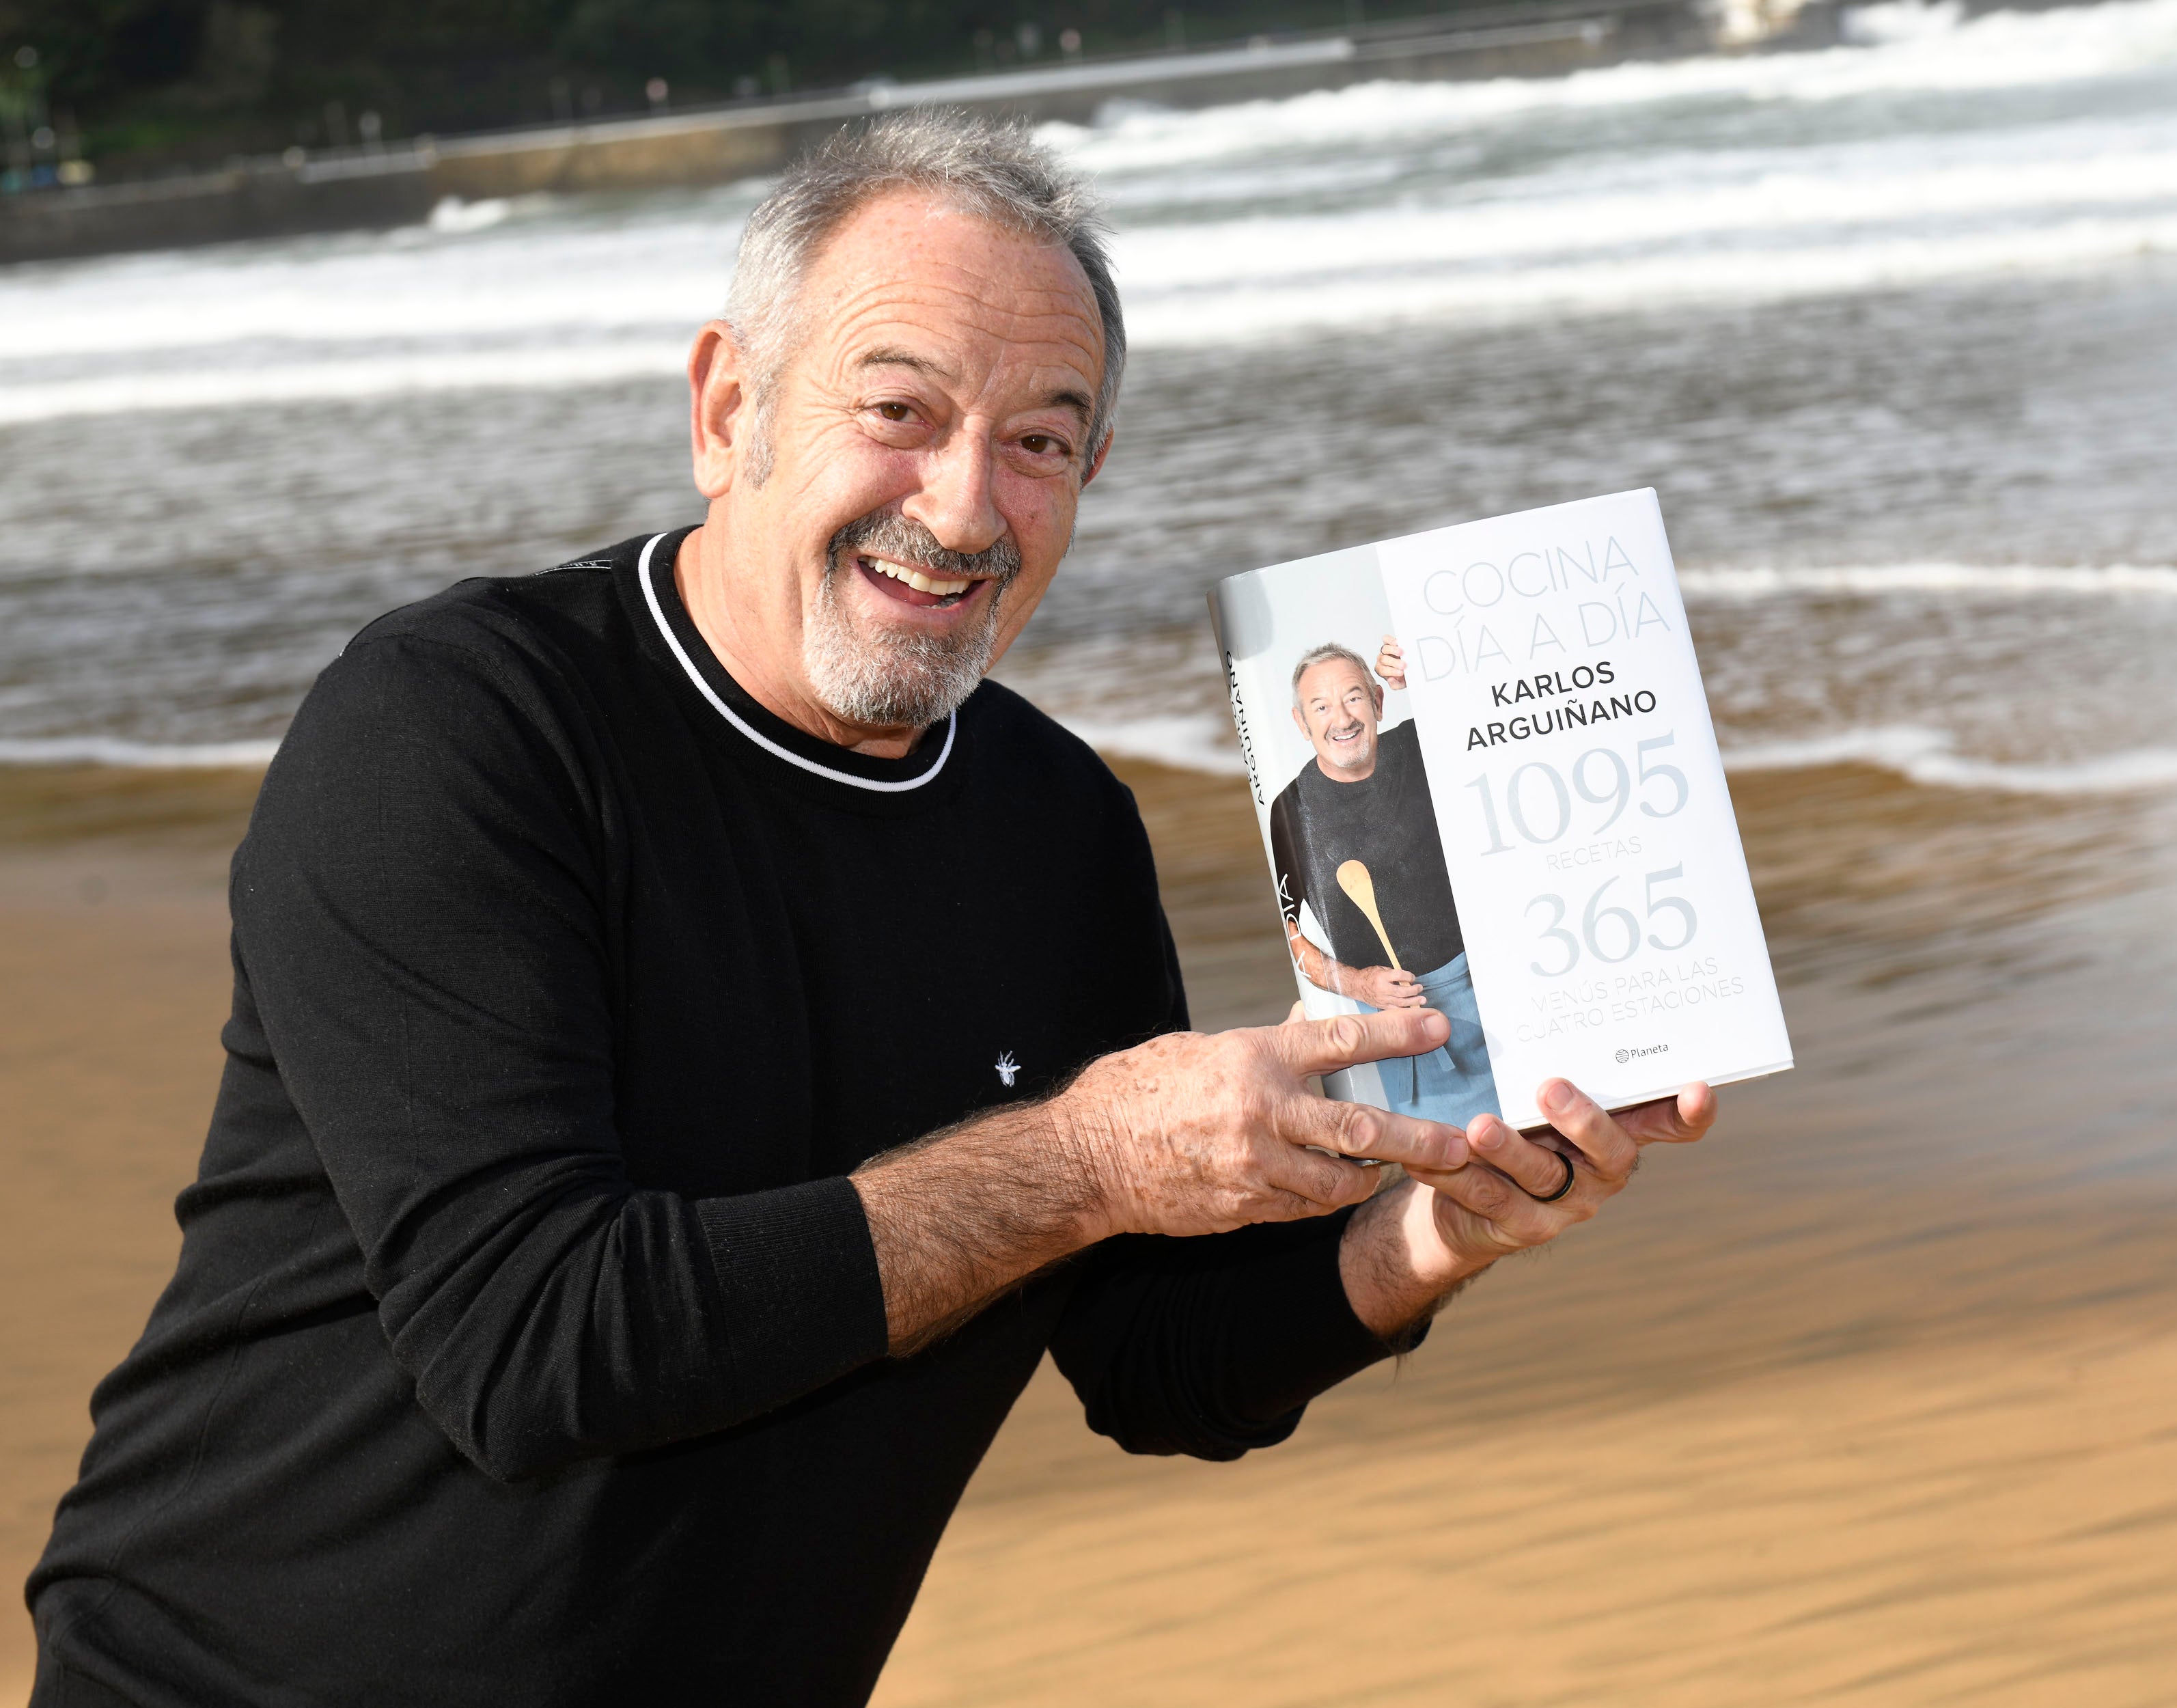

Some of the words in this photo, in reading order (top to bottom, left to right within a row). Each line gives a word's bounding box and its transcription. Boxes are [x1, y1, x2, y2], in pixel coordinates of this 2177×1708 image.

[1423, 535, 1639, 615] COCINA
[1415, 615, 1512, 683] DÍA
[1529, 612, 1567, 660] A
[1577, 581, 1672, 648] DÍA
[1490, 661, 1616, 707] KARLOS
[1467, 690, 1657, 752] ARGUIÑANO
[1464, 728, 1689, 857] 1095
[1545, 836, 1643, 872] RECETAS
[1522, 860, 1698, 978] 365
[1516, 1008, 1604, 1043] CUATRO
[1611, 976, 1745, 1021] ESTACIONES
[1531, 980, 1608, 1014] MENÚS
[1614, 967, 1673, 995] PARA
[1677, 956, 1719, 982] LAS
[1631, 1044, 1669, 1059] Planeta
